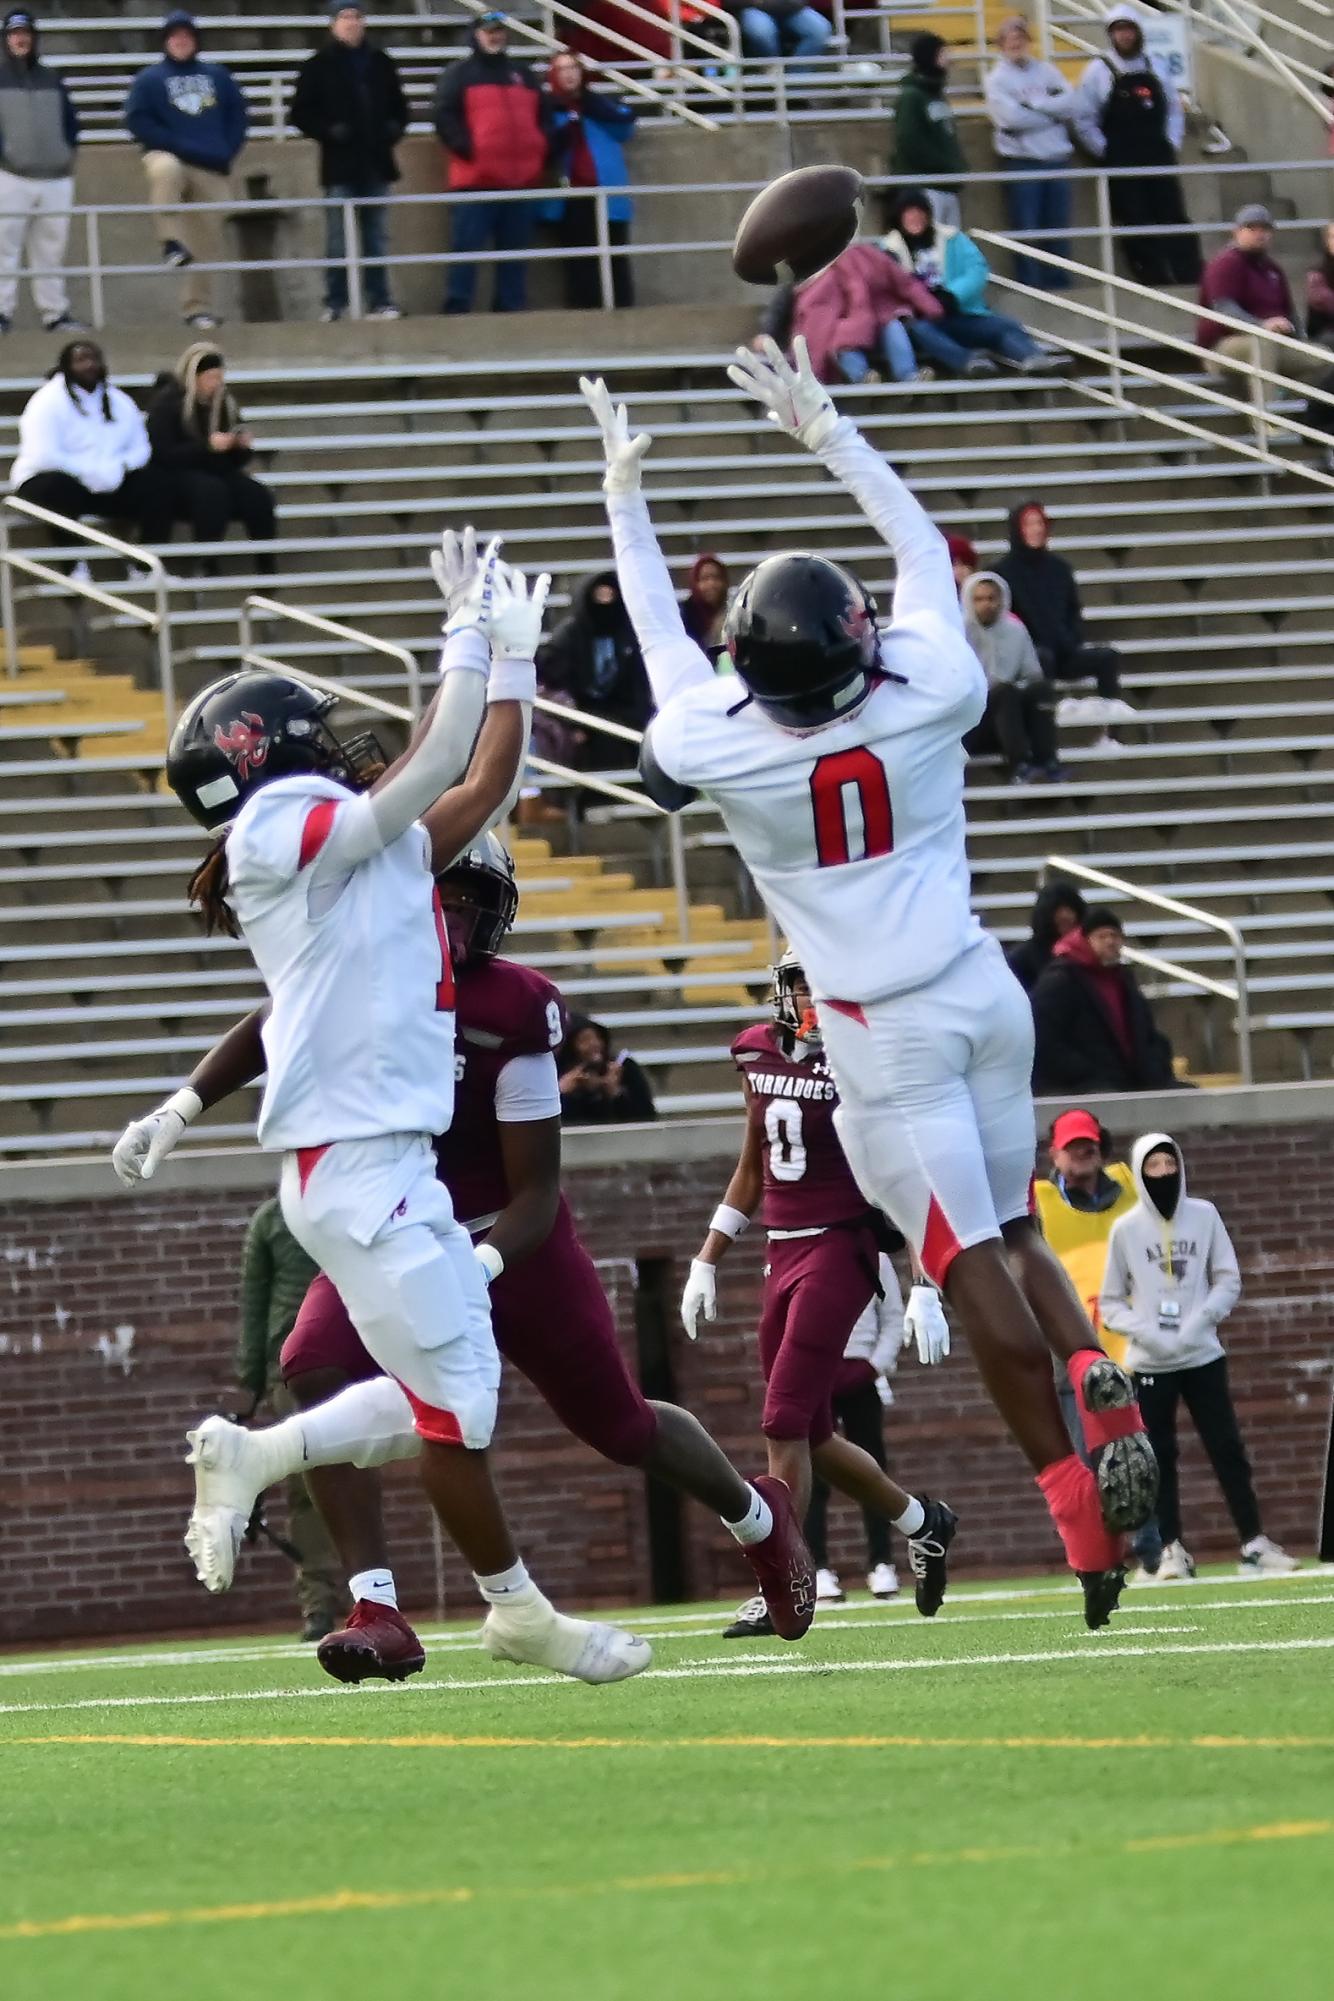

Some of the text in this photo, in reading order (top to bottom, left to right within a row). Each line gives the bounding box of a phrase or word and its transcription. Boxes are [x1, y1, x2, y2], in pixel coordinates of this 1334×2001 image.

[545, 1000, 563, 1048] 9
[748, 1072, 835, 1100] TORNADOES
[764, 1098, 807, 1181] 0
